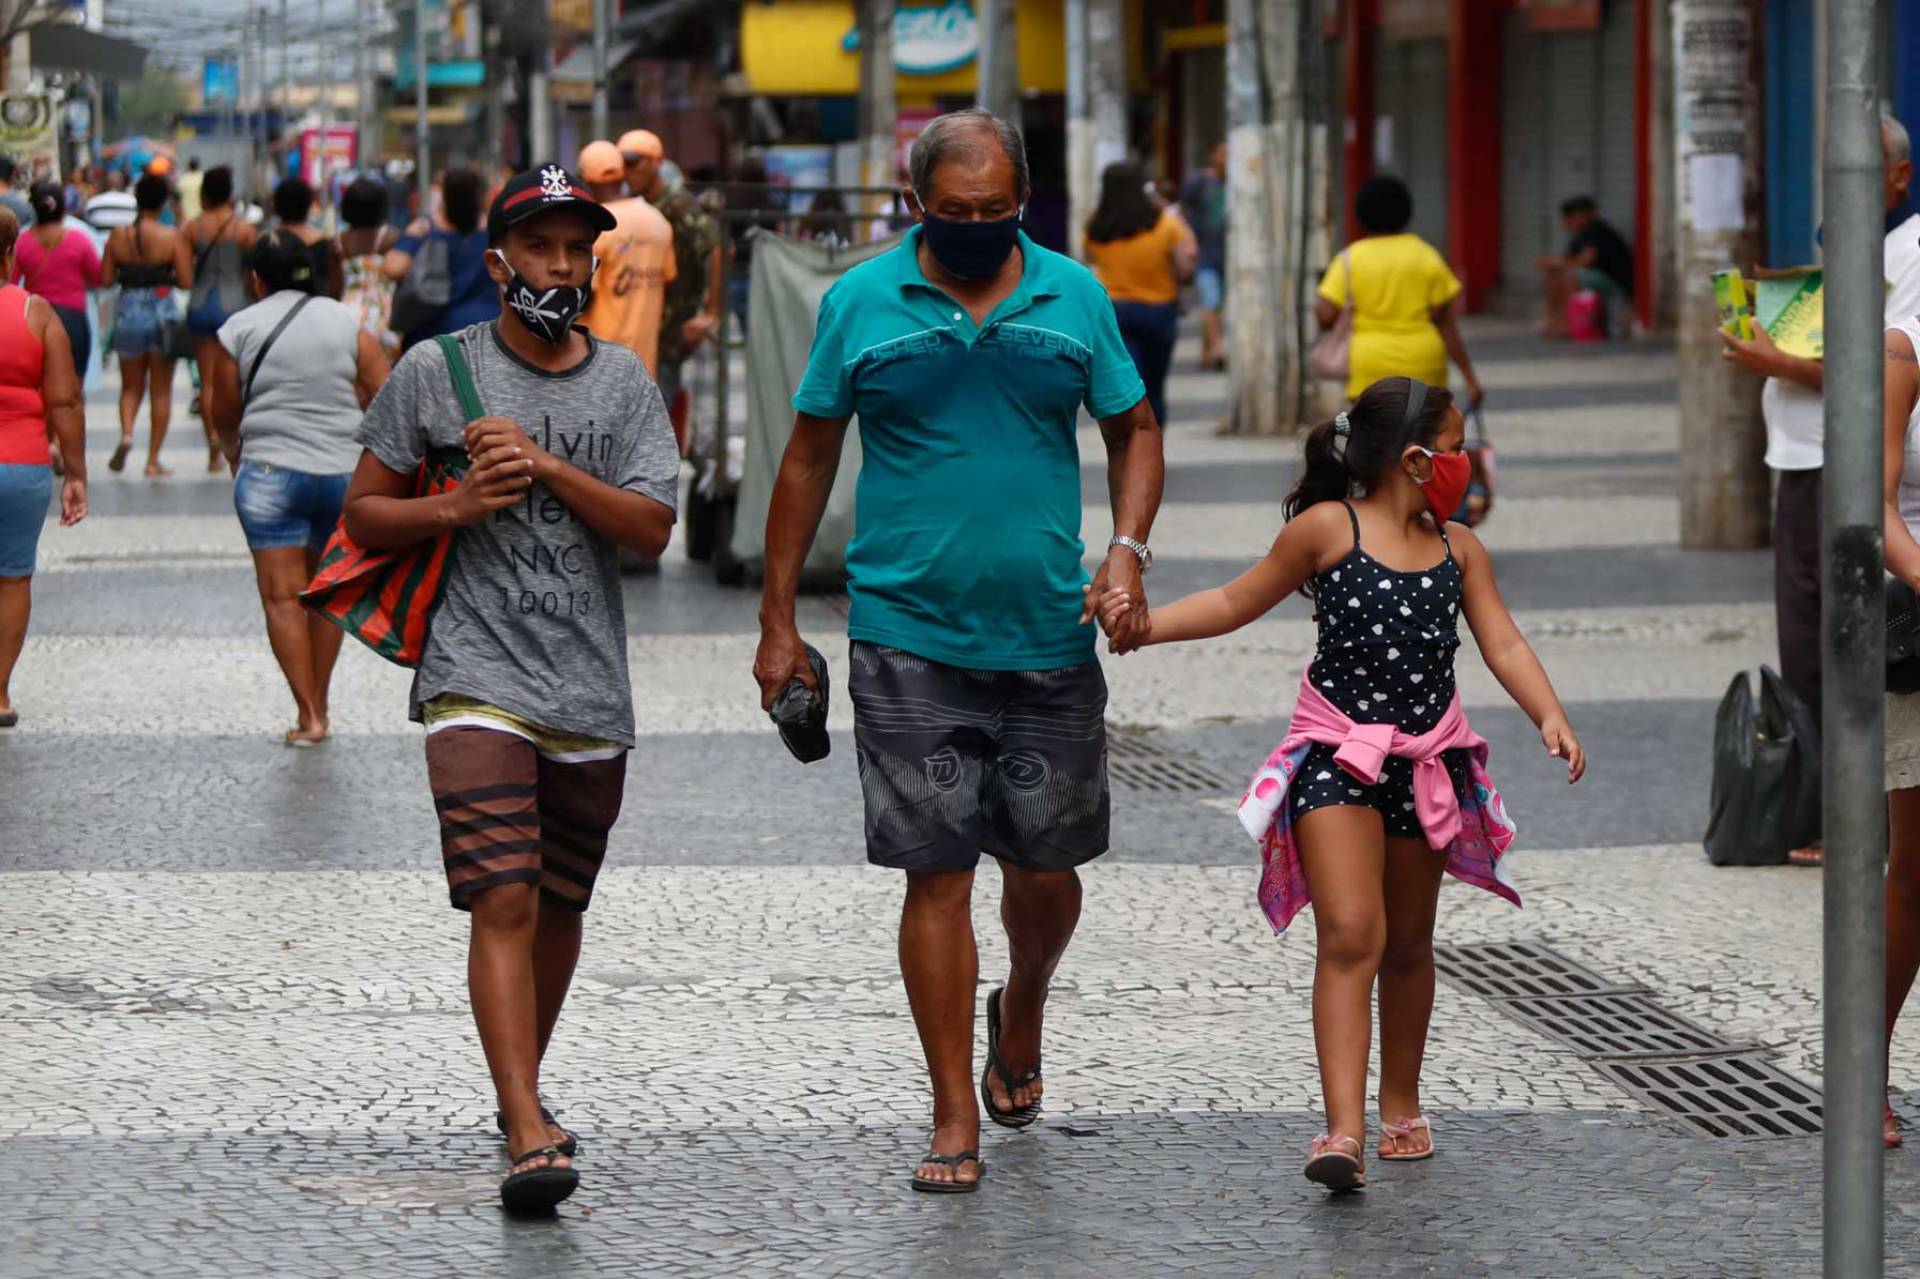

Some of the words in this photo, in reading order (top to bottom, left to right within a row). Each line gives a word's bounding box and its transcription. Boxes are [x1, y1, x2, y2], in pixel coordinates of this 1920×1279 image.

[528, 415, 614, 462] lvin
[510, 544, 584, 575] NYC
[501, 587, 591, 616] 10013
